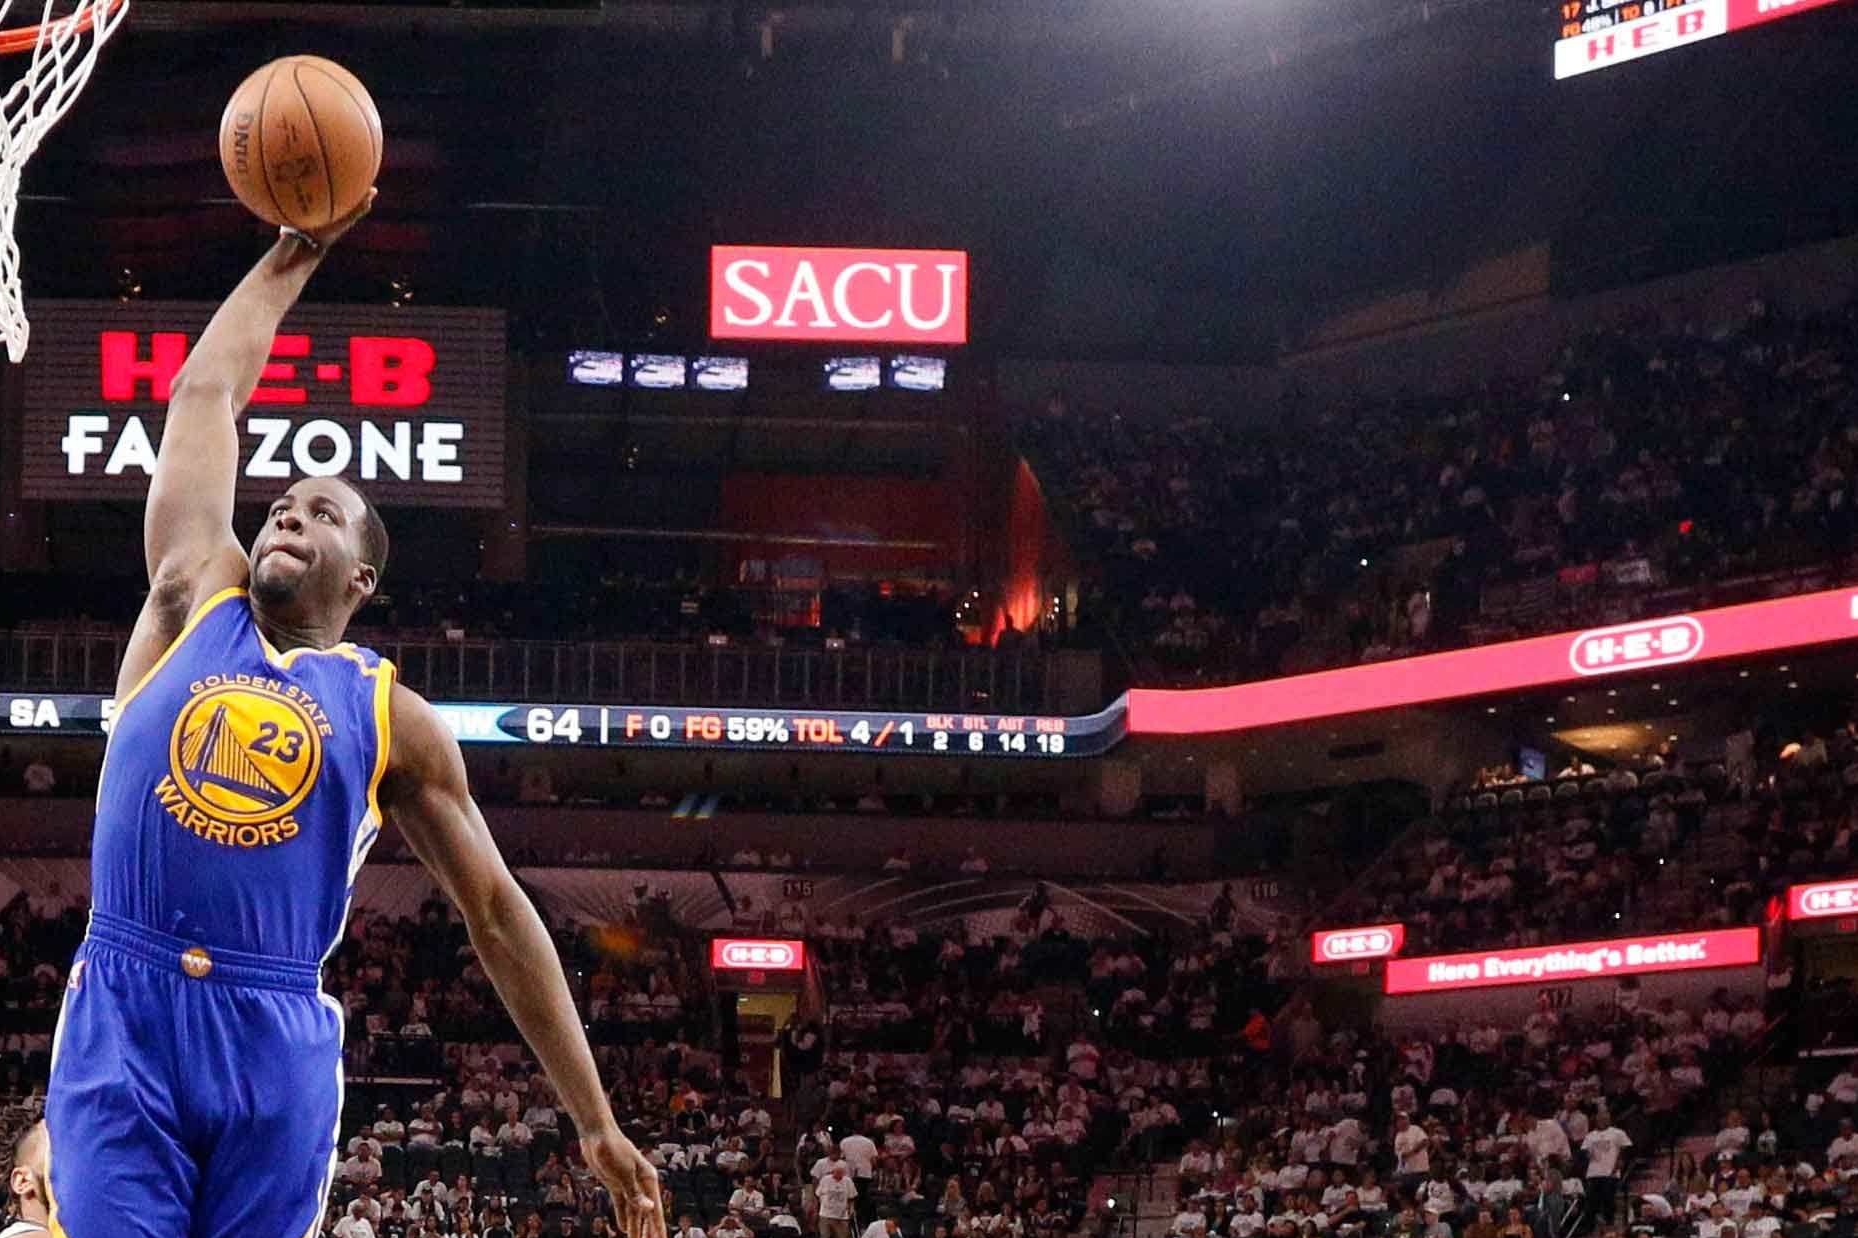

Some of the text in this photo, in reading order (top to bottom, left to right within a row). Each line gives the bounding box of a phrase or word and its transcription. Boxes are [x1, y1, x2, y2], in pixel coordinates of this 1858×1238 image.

[724, 260, 958, 329] SACU
[61, 415, 464, 482] FA ZONE
[9, 699, 60, 727] SA
[190, 674, 334, 737] GOLDEN STATE
[526, 708, 582, 743] 64
[626, 713, 643, 738] F
[685, 714, 722, 740] FG
[727, 716, 789, 742] 59%
[793, 718, 845, 744] TOL
[926, 716, 1065, 732] BLK STL AST REB
[249, 721, 304, 763] 23
[933, 732, 948, 750] 2
[968, 732, 984, 751] 6
[999, 732, 1026, 752] 14
[155, 775, 300, 847] WARRIORS
[1429, 962, 1479, 982] Here
[1485, 947, 1620, 980] Everything's
